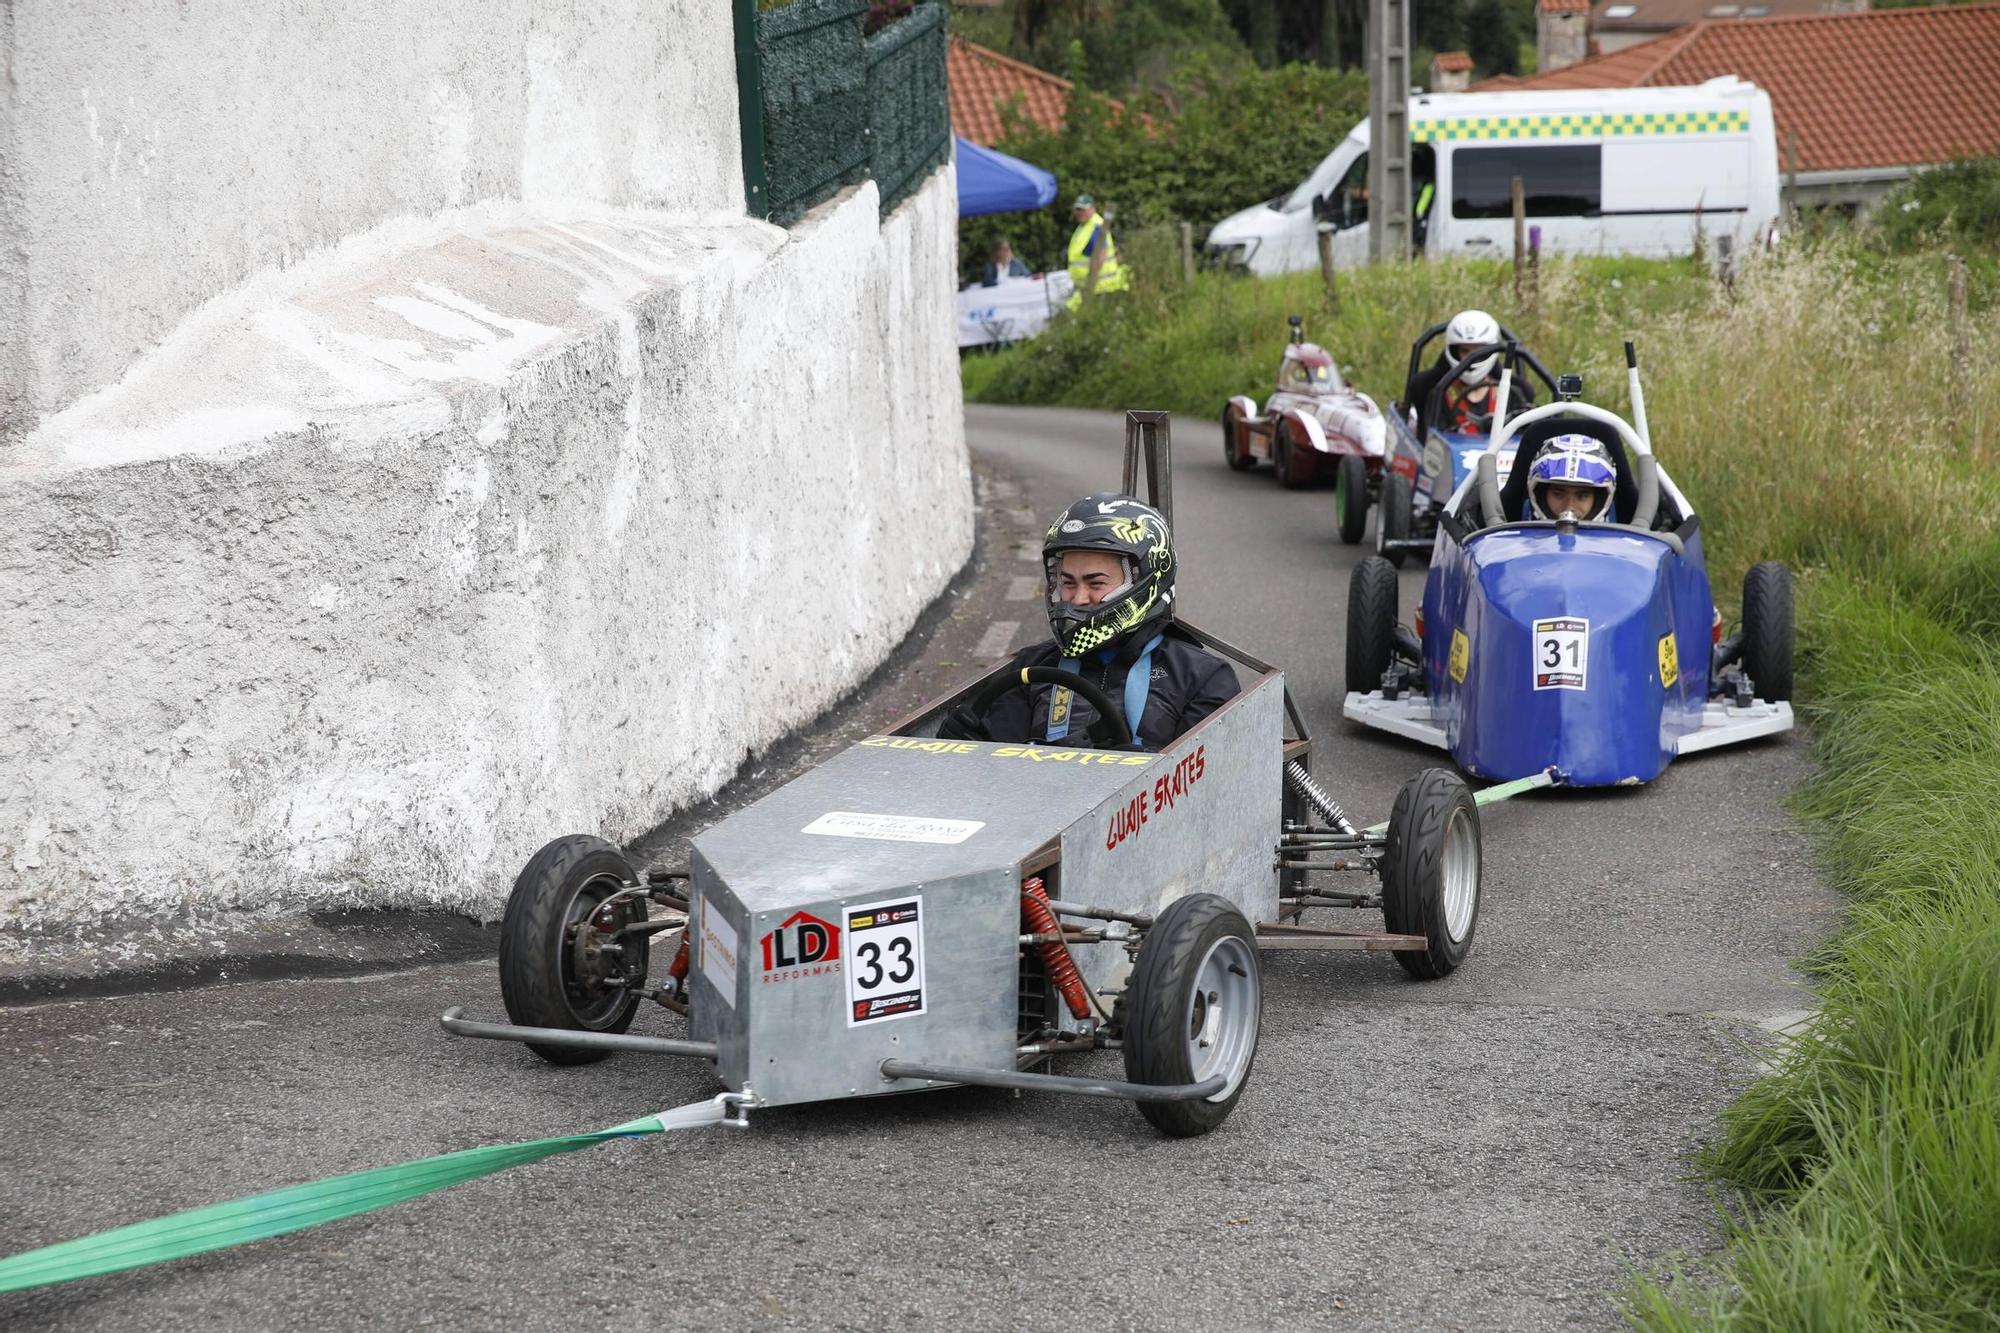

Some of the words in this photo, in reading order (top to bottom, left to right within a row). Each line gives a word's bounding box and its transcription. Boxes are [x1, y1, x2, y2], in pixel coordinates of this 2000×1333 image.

[1543, 639, 1579, 668] 31
[990, 746, 1153, 766] SKATES
[1154, 744, 1205, 814] SKATES
[775, 923, 828, 968] LD
[856, 936, 915, 990] 33
[763, 964, 841, 983] REFORMAS
